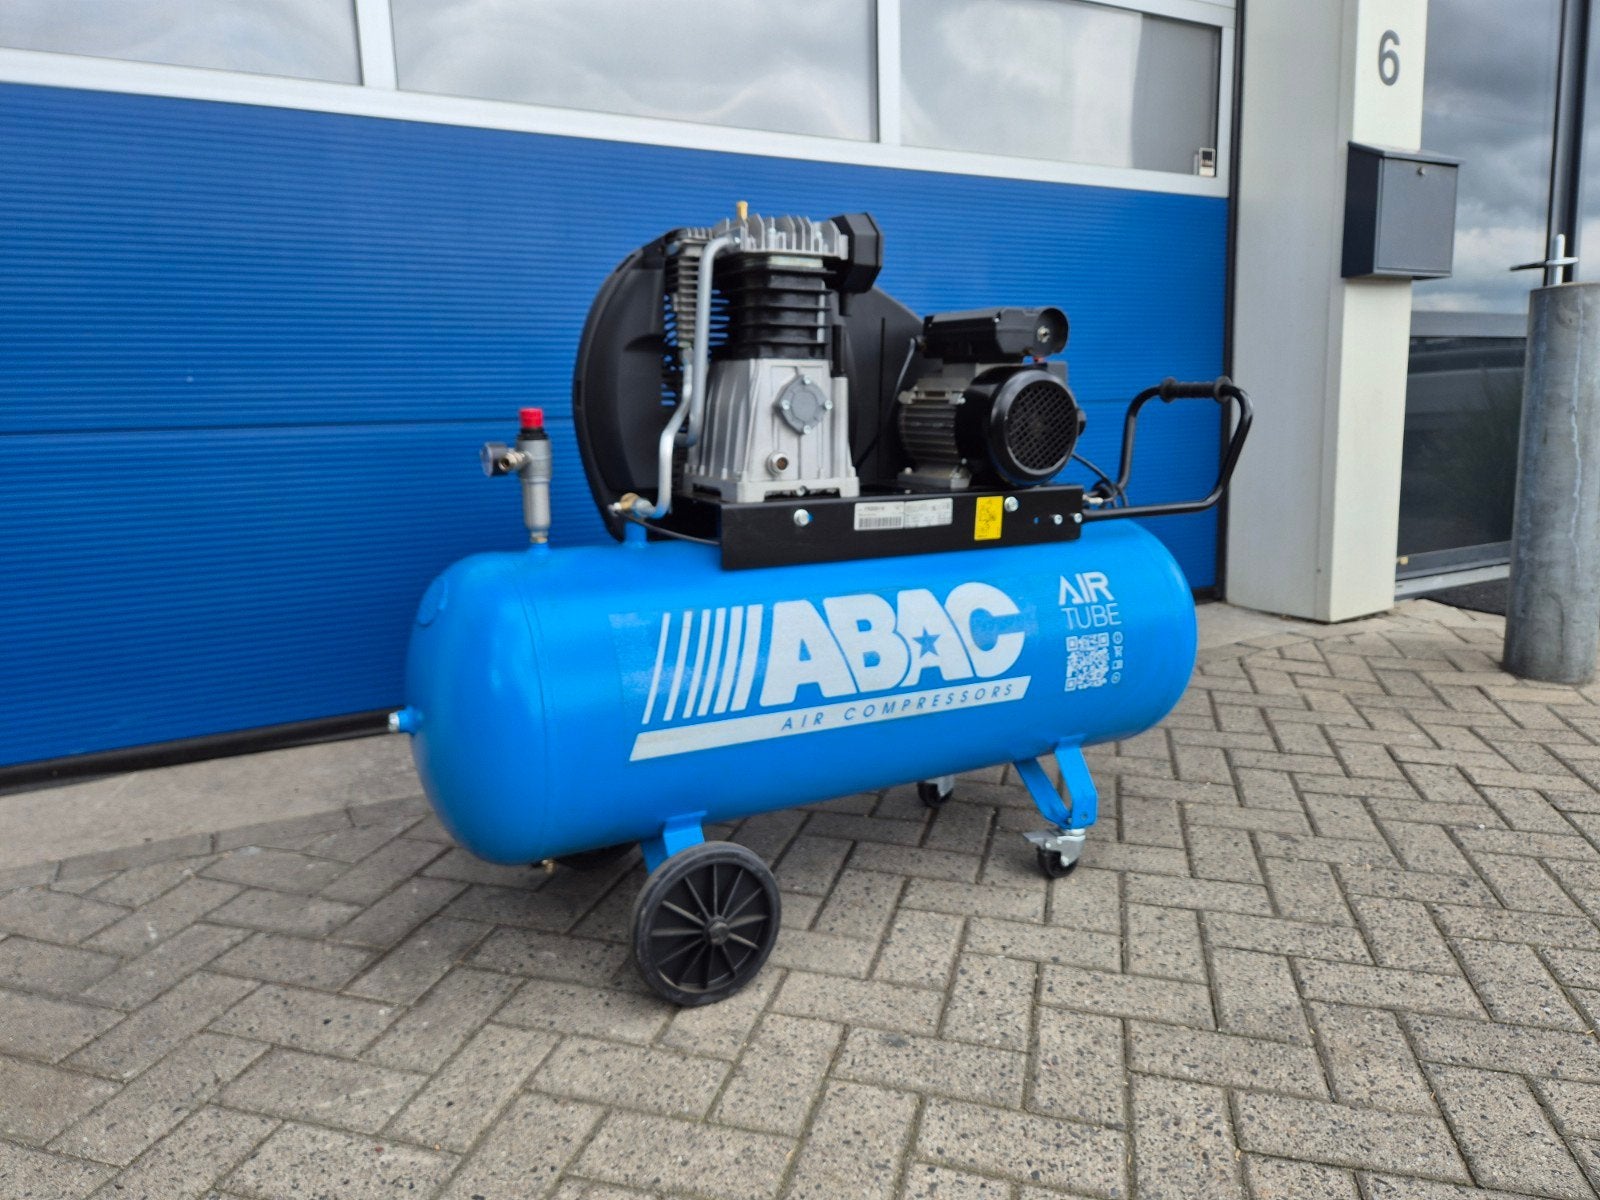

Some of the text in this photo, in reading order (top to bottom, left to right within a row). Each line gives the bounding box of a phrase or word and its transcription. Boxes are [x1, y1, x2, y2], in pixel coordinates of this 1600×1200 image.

[1378, 29, 1400, 86] 6
[1058, 571, 1115, 606] AIR
[1061, 602, 1122, 630] TUBE
[759, 582, 1025, 707] ABAC
[781, 683, 1014, 732] AIR COMPRESSORS
